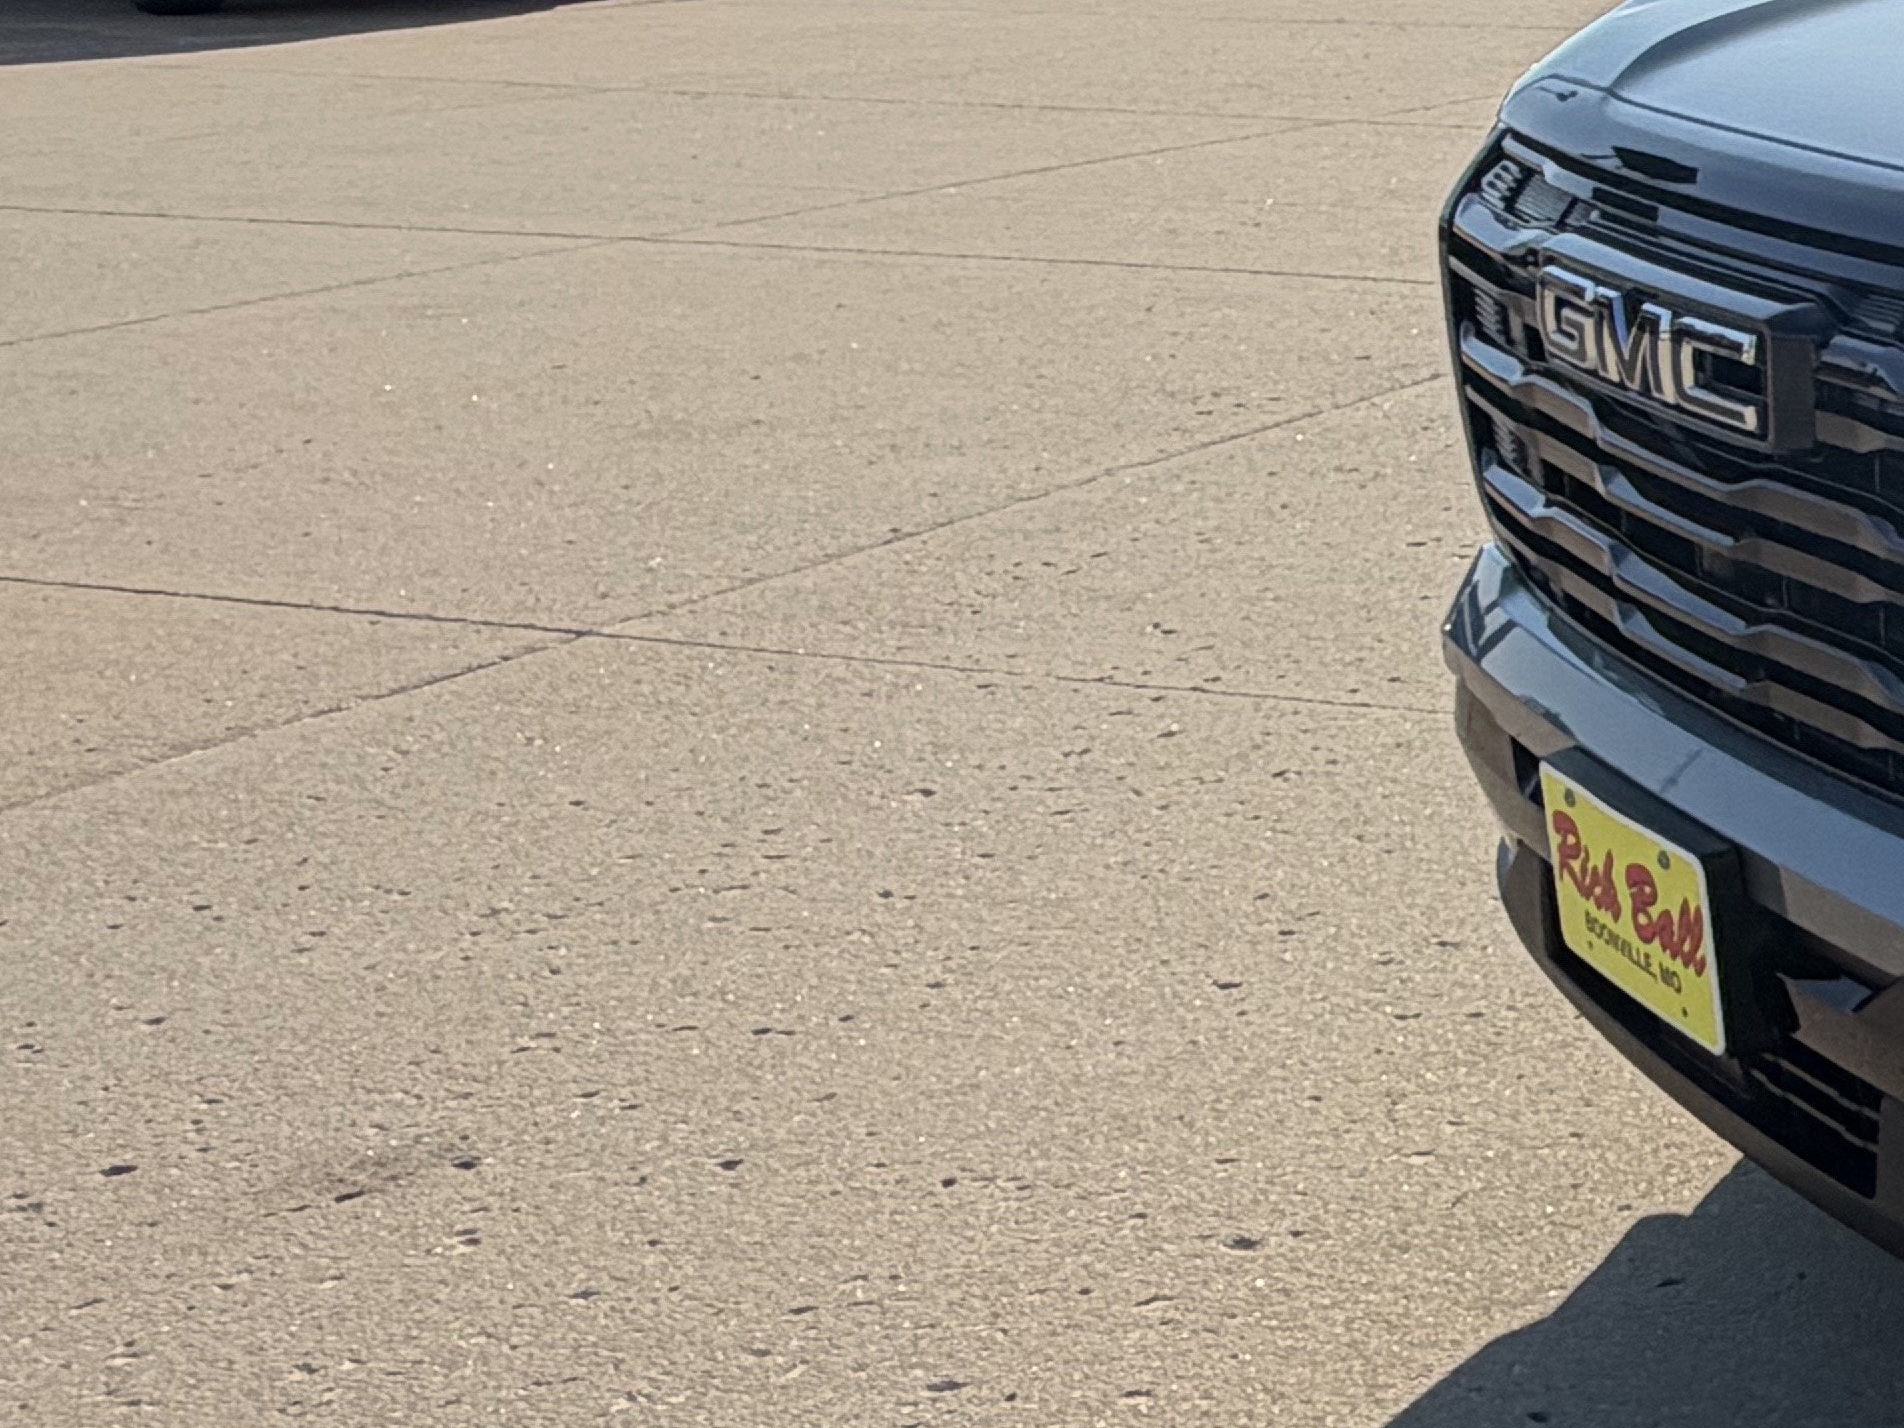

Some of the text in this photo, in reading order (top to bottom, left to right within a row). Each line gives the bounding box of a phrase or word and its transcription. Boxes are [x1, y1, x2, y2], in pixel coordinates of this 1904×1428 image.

[1540, 265, 1759, 432] GMC
[1552, 809, 1707, 978] Rick Ball
